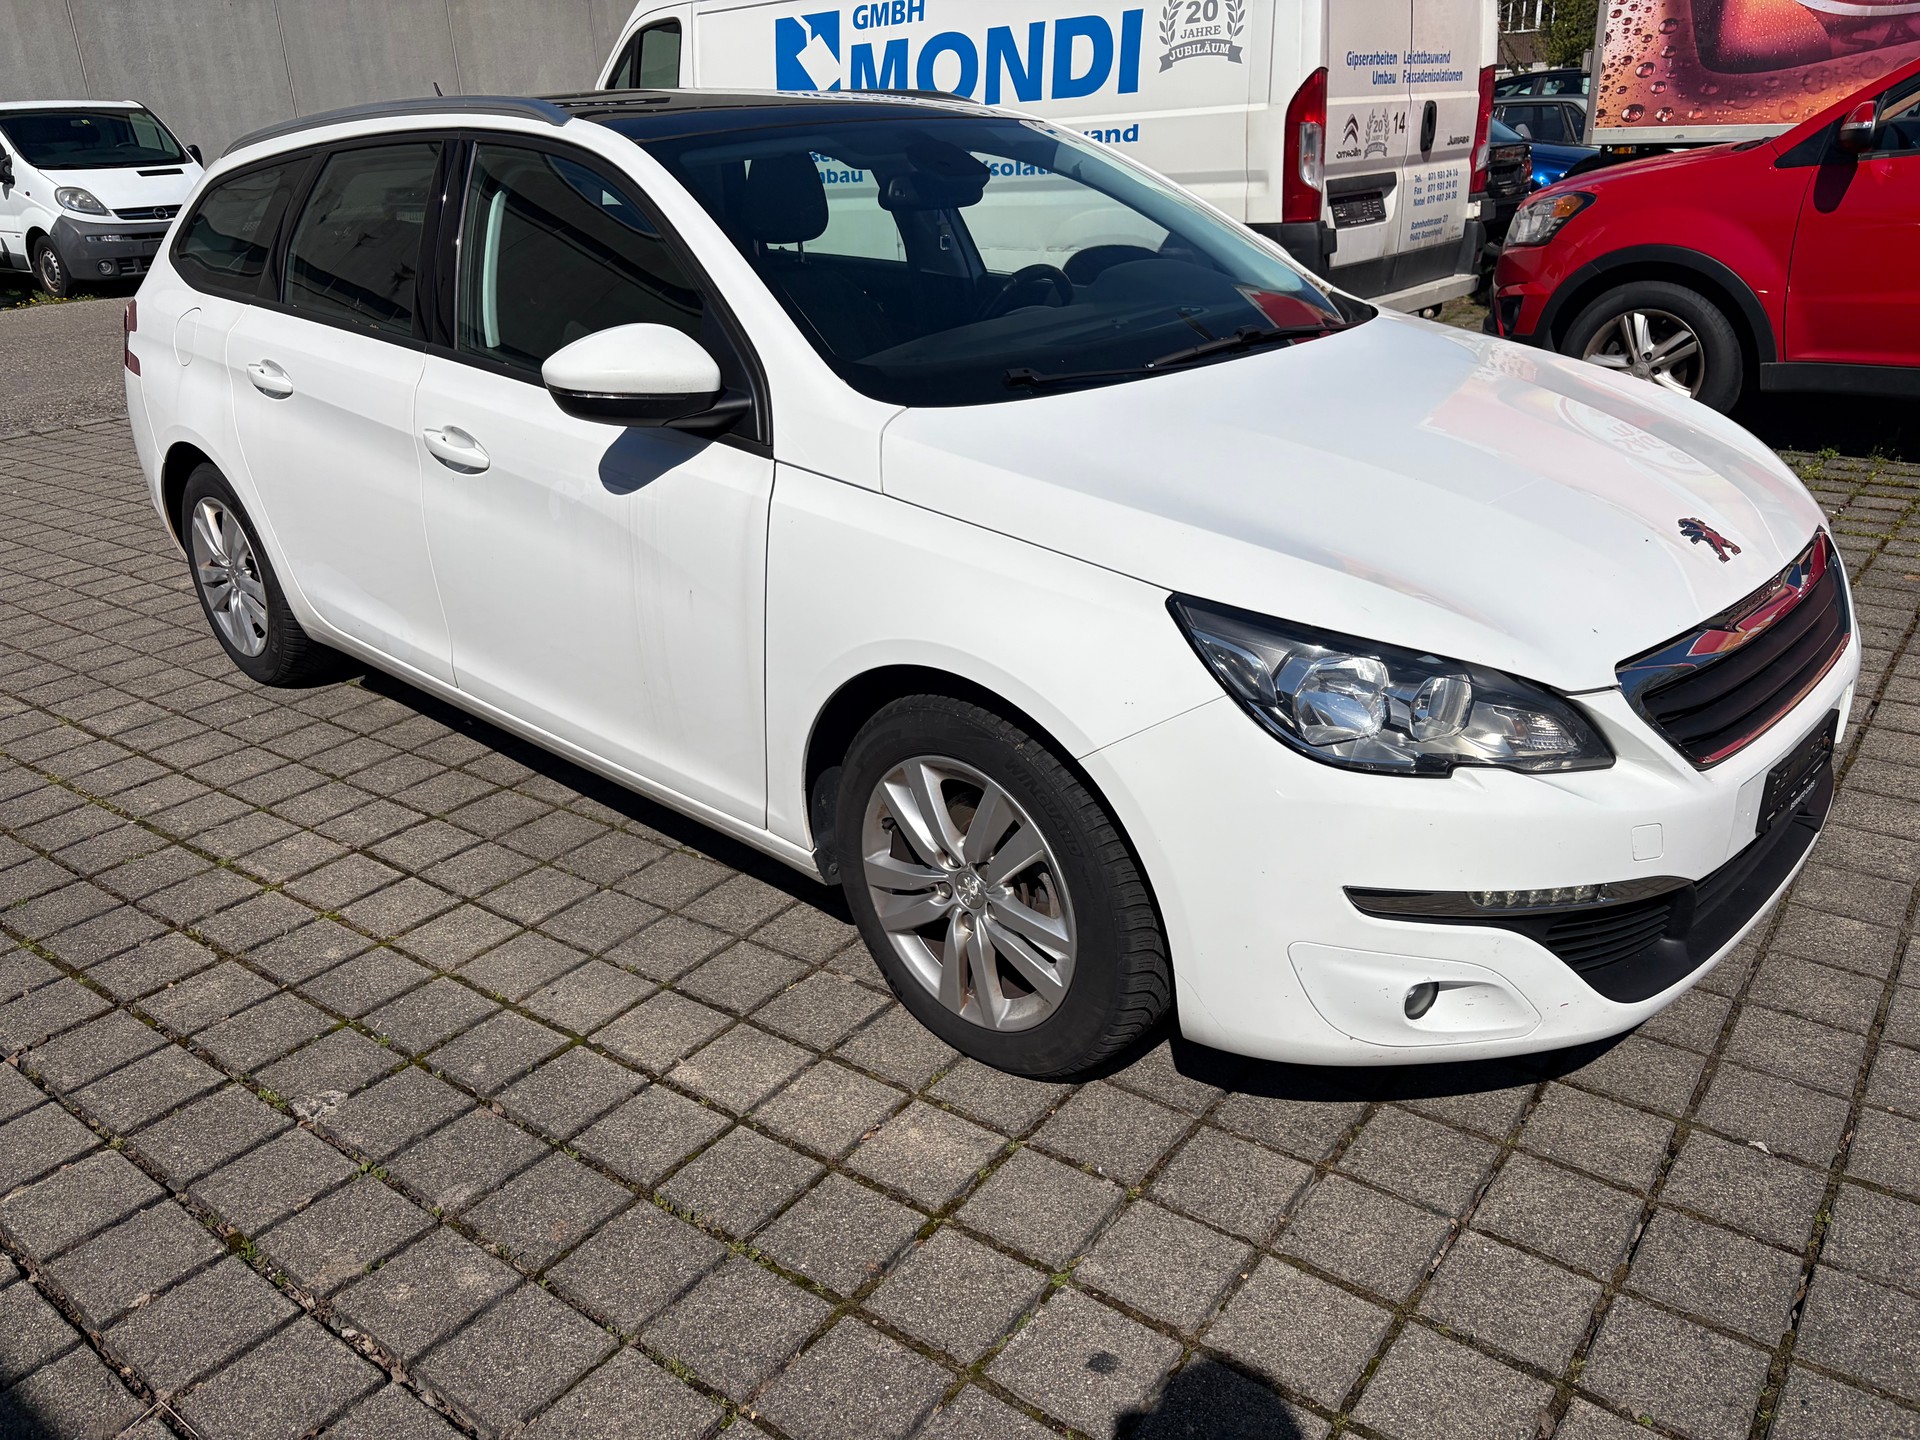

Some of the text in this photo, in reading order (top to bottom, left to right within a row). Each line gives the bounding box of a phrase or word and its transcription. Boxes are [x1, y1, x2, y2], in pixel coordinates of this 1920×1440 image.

[852, 0, 925, 30] GMBH
[1185, 0, 1219, 25] 20
[1180, 25, 1222, 39] JAHRE
[850, 8, 1145, 106] MONDI
[1169, 41, 1231, 61] JUBILÄUM
[1346, 50, 1451, 70] Gipserarbeiten Leichtbauwand
[1372, 68, 1463, 85] Umbau Fassadenisolationen
[1373, 119, 1383, 133] 20
[1393, 111, 1406, 134] 14
[1083, 123, 1139, 143] and
[1414, 186, 1422, 195] Fax
